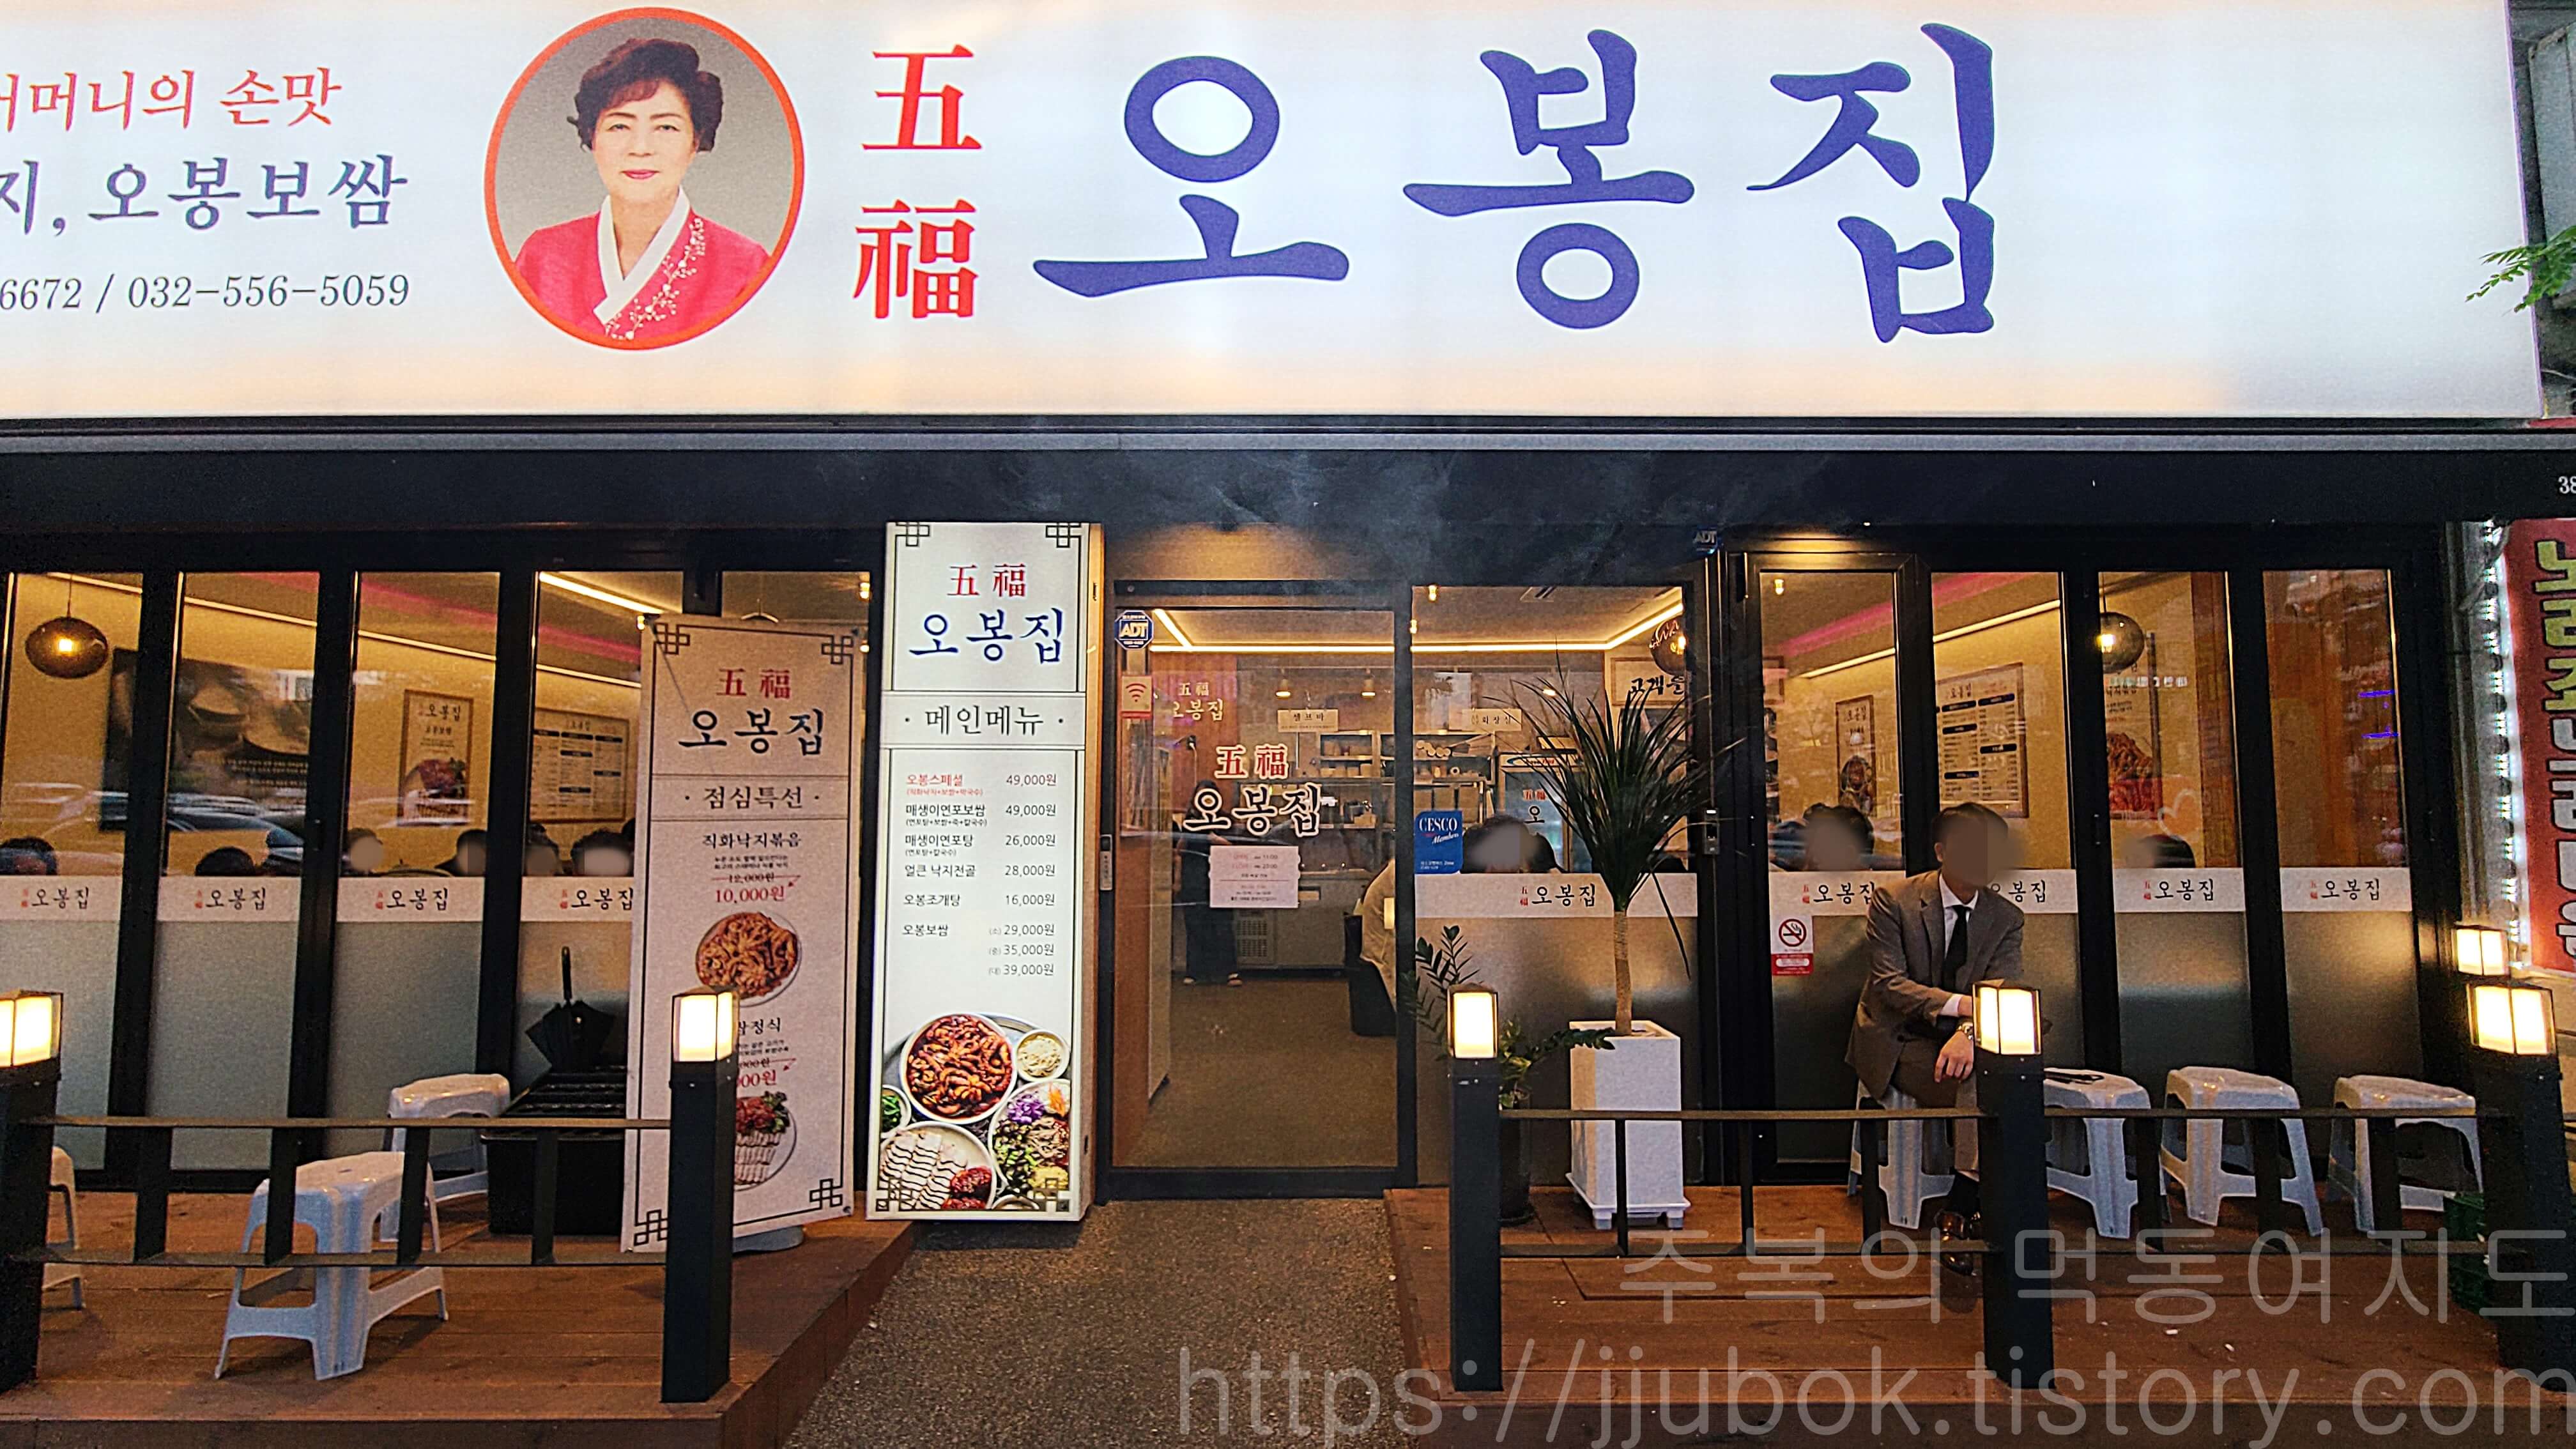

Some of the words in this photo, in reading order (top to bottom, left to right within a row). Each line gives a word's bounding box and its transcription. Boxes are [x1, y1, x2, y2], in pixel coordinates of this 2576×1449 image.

[220, 67, 342, 127] 손맛
[88, 155, 408, 230] 오봉보쌈
[852, 44, 982, 319] 五福
[1033, 23, 1995, 342] 오봉집
[128, 274, 410, 309] 032-556-5059
[947, 564, 1026, 597] 五福
[908, 608, 1062, 664] 오봉집
[1119, 622, 1148, 638] ADT
[716, 668, 792, 699] 五福
[678, 707, 824, 756] 오봉집
[925, 705, 1043, 736] 메인메뉴
[1215, 744, 1288, 779] 五福
[1006, 773, 1056, 786] 49,000원
[704, 786, 803, 809] 점심특선
[905, 804, 986, 817] 매생이연포보쌈
[1006, 804, 1056, 817] 49,000원
[1183, 782, 1322, 837] 오봉집
[1419, 817, 1458, 832] CESCO
[703, 832, 801, 849] 직화낙지볶음
[905, 834, 974, 847] 매생이연포탕
[1005, 834, 1055, 847] 26,000원
[905, 864, 926, 878] 얼큰
[931, 864, 976, 878] 낙지전골
[1005, 864, 1055, 878] 28,000원
[32, 887, 89, 910] 오봉집
[206, 887, 266, 910] 오봉집
[385, 887, 448, 910] 오봉집
[571, 887, 634, 910] 오봉집
[903, 894, 960, 907] 오봉조개탕
[1006, 893, 1055, 907] 16,000원
[1531, 884, 1595, 907] 오봉집
[1813, 882, 1876, 905] 오봉집
[2154, 879, 2214, 901] 오봉집
[2321, 878, 2380, 901] 오봉집
[902, 924, 948, 937] 오봉보쌈
[1004, 923, 1054, 937] 29,000원
[1004, 943, 1054, 956] 35,000원
[1004, 963, 1054, 976] 39,000원
